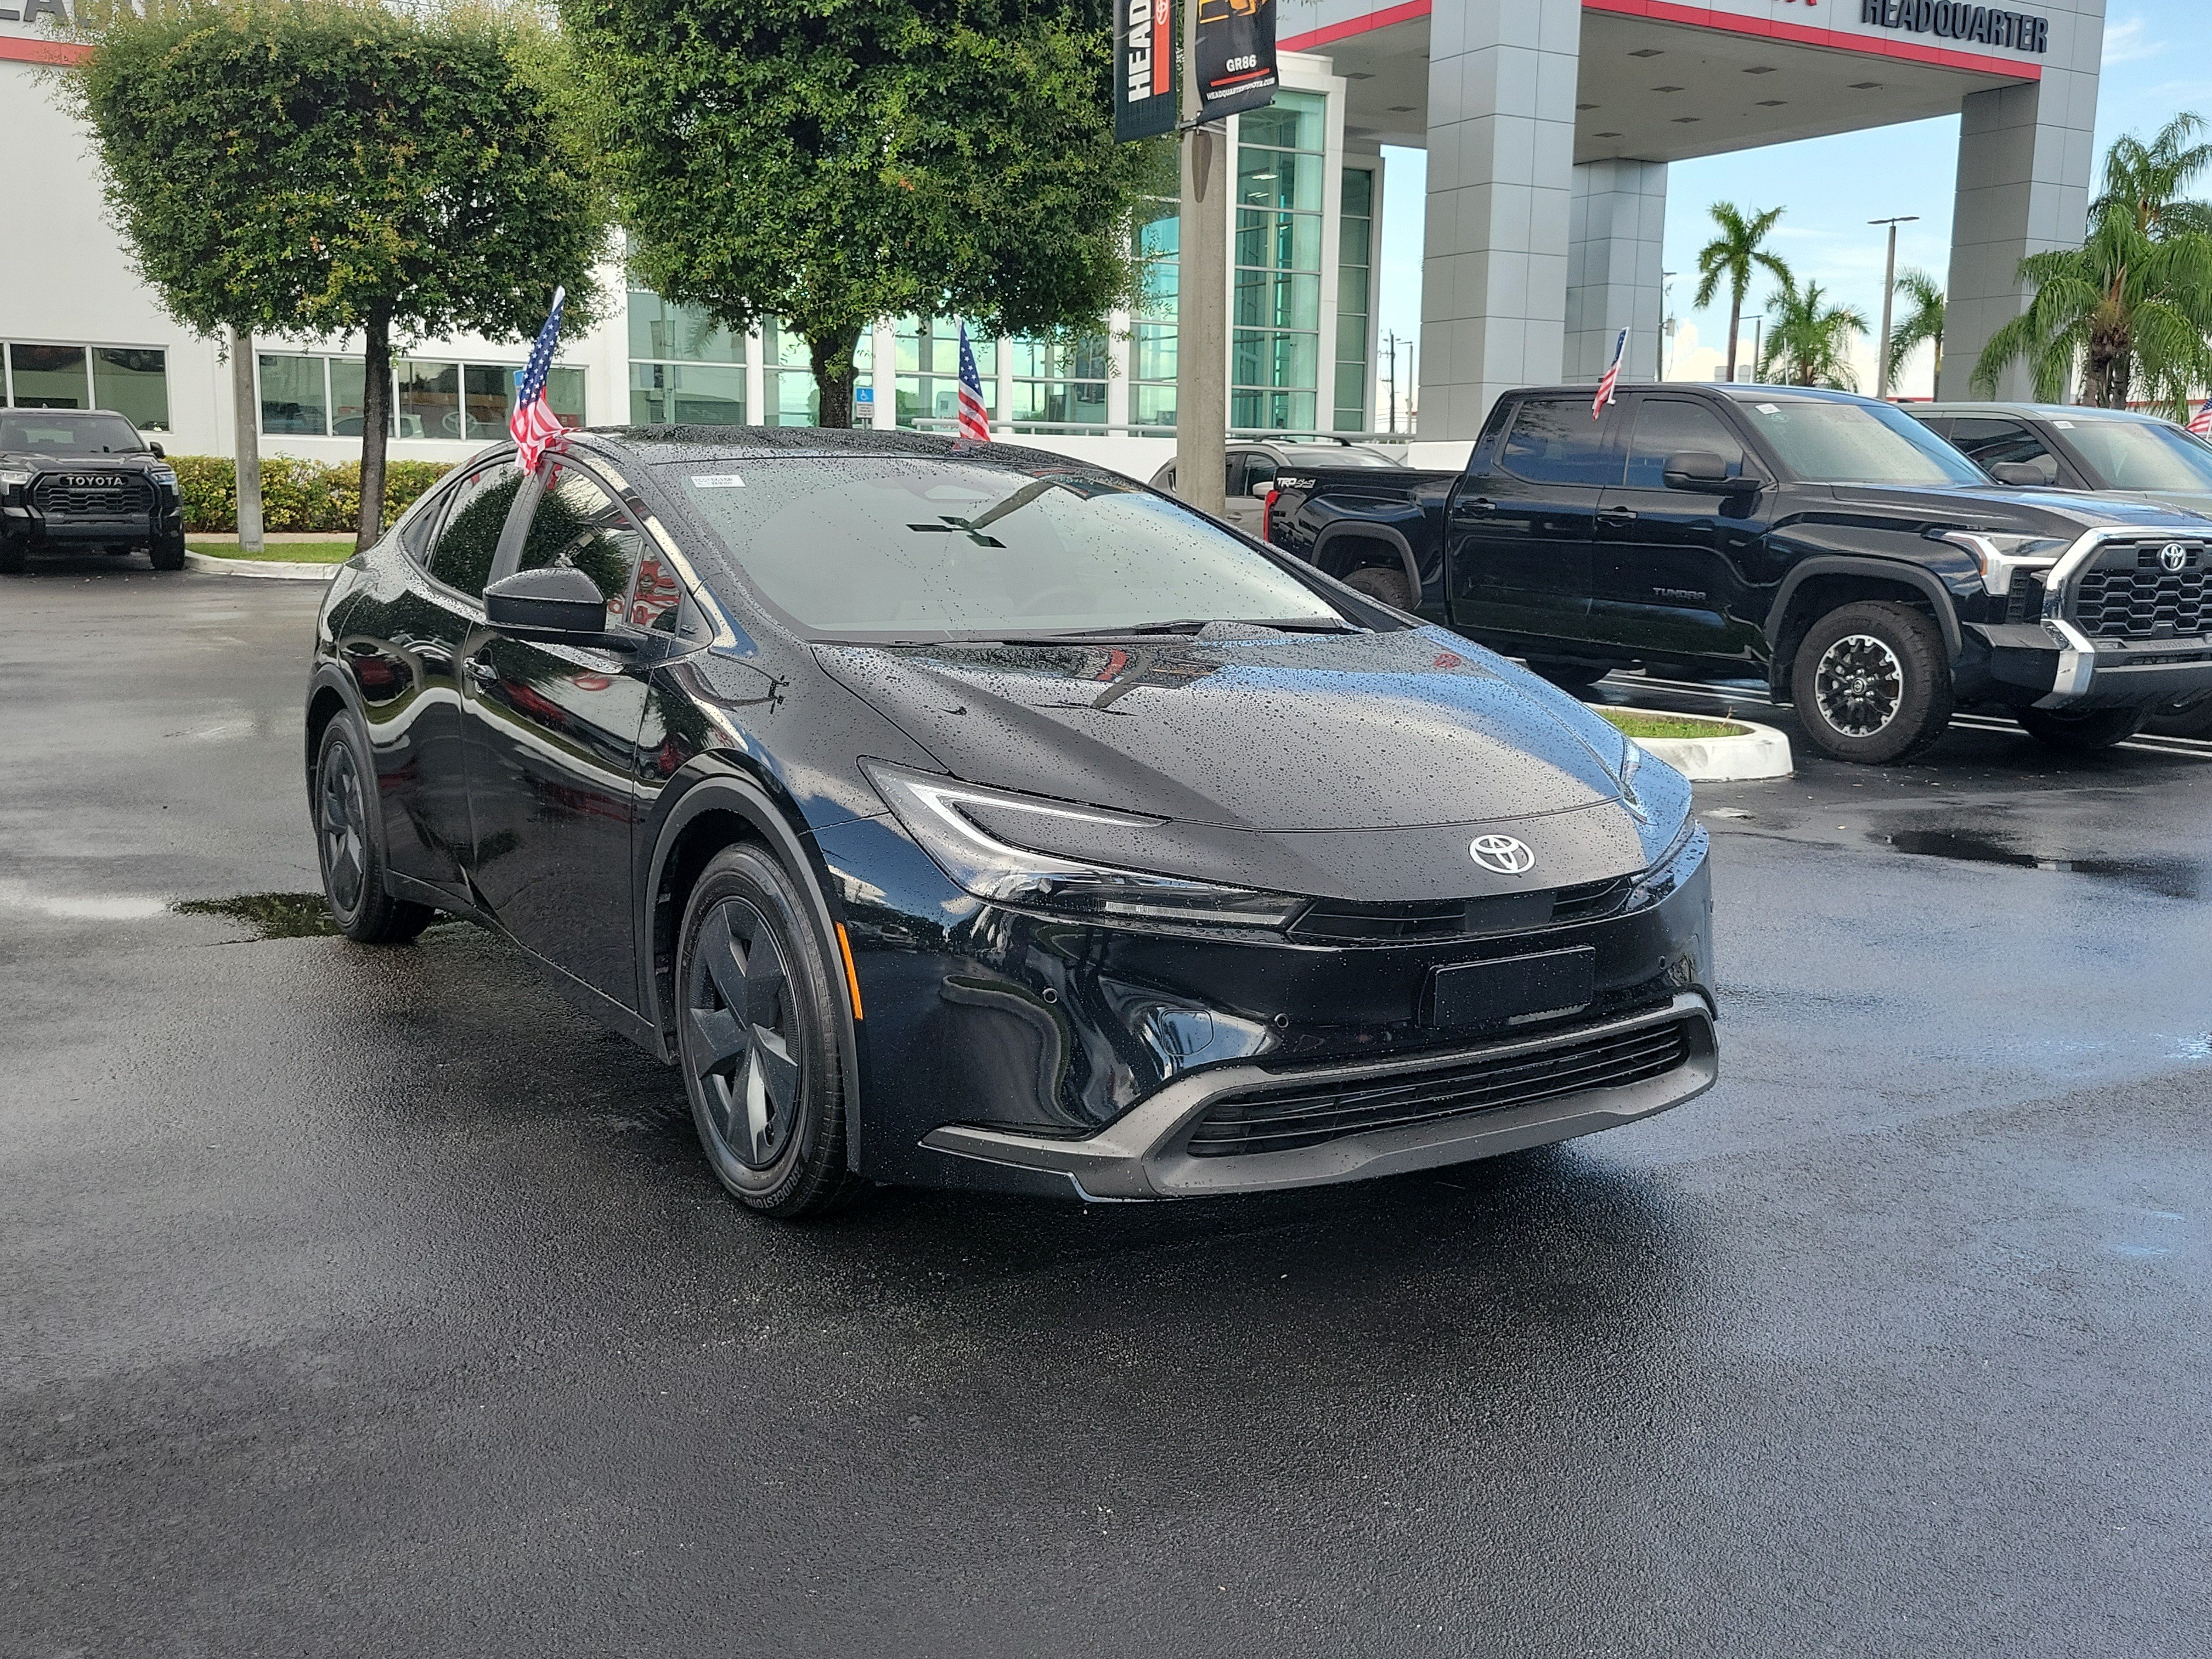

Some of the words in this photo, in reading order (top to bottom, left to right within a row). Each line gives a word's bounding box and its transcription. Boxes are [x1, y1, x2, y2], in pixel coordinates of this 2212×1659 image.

[1861, 0, 2049, 53] HEADQUARTER
[1226, 54, 1257, 72] GR86
[66, 476, 124, 486] TOYOTA
[1277, 477, 1297, 487] TRD
